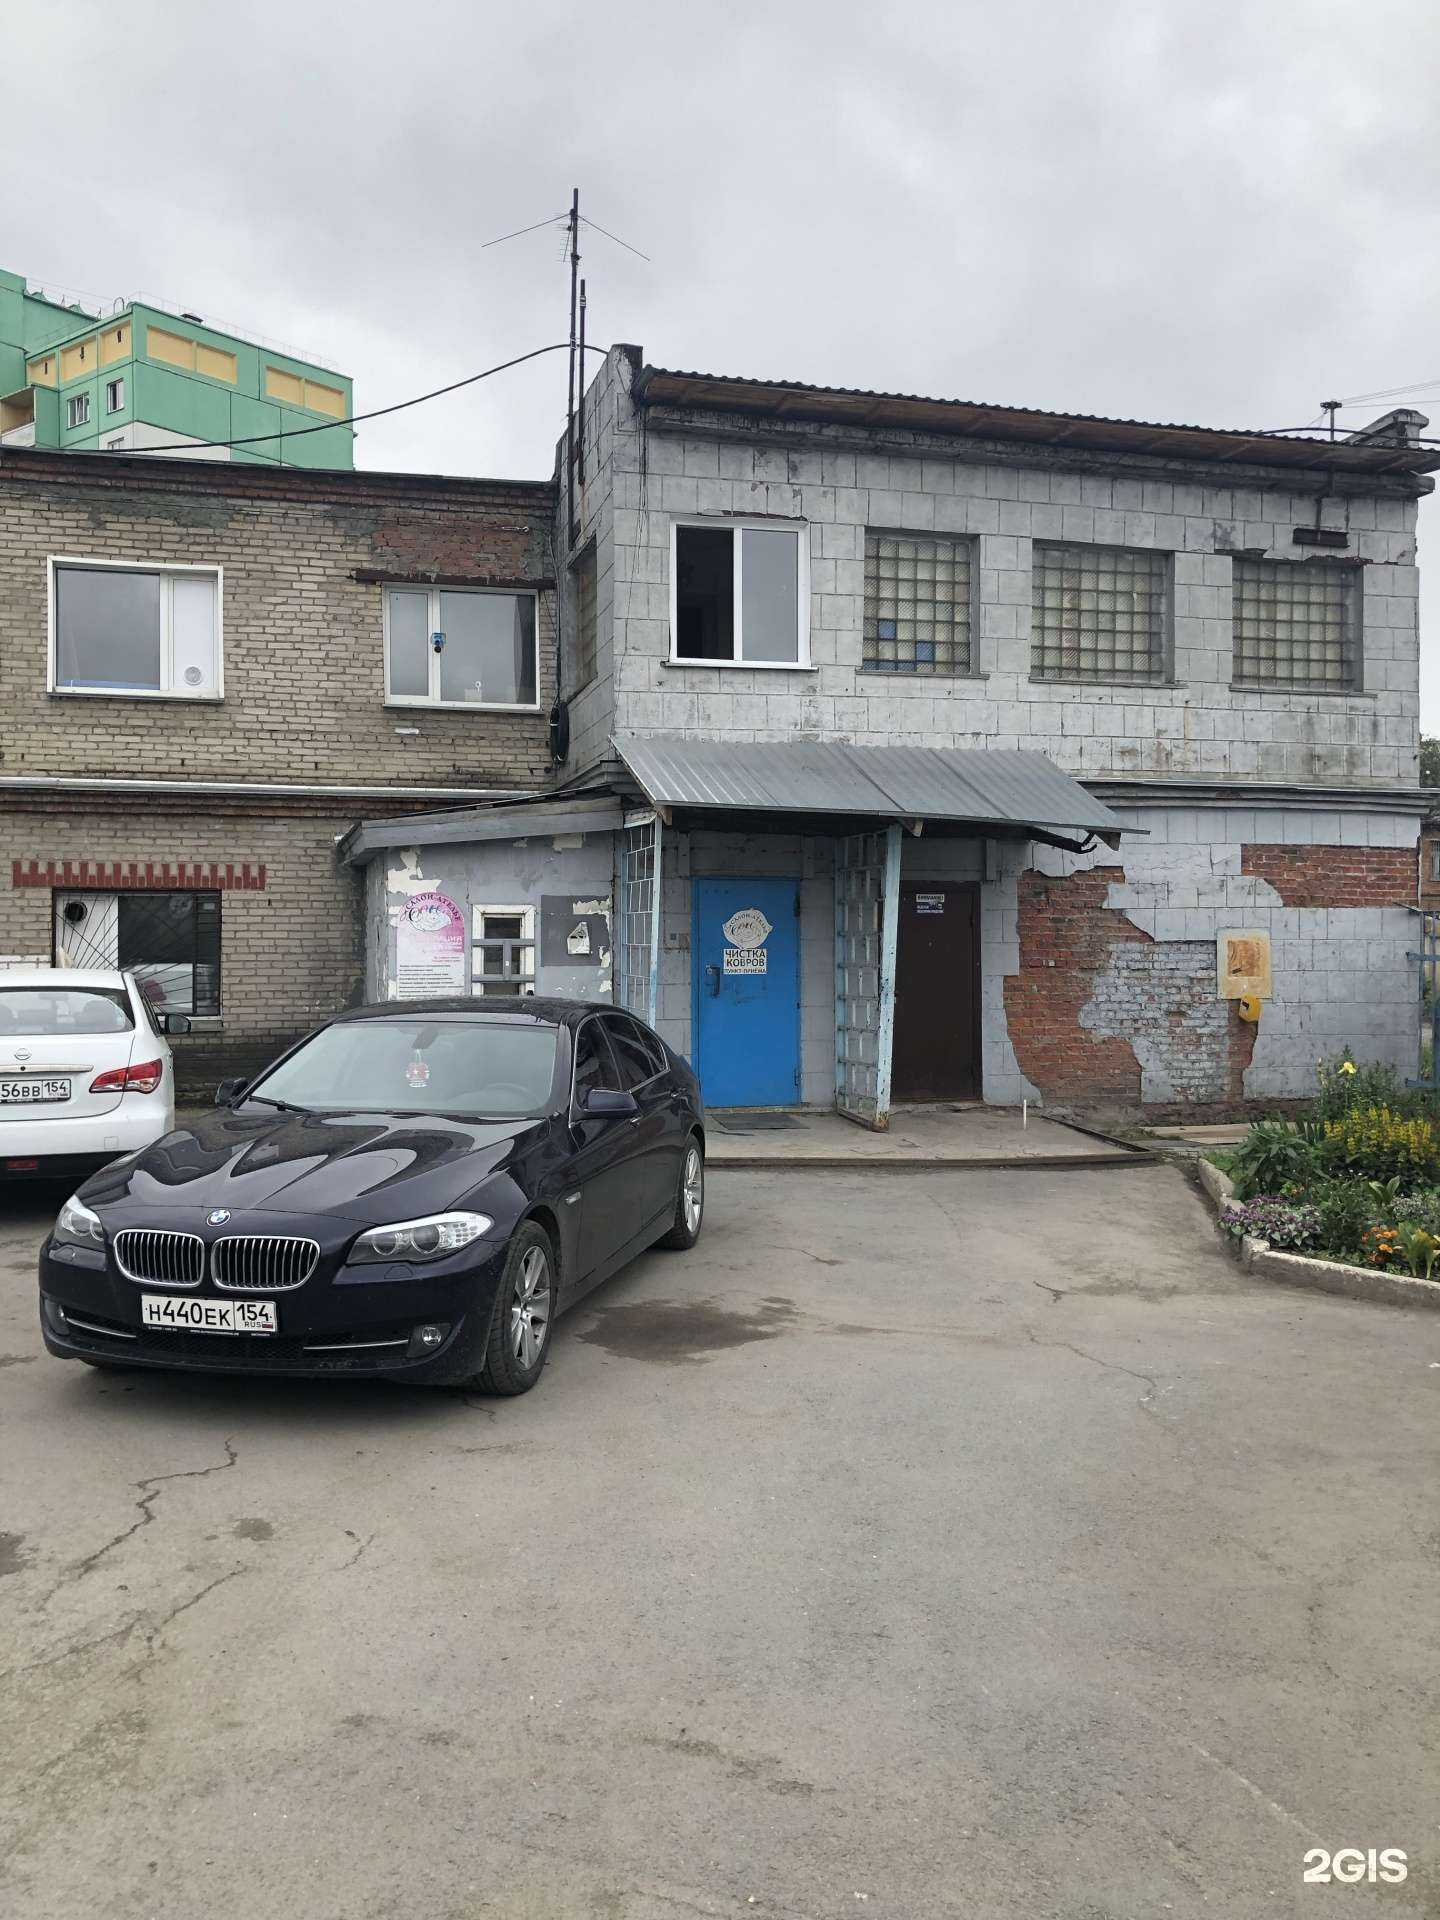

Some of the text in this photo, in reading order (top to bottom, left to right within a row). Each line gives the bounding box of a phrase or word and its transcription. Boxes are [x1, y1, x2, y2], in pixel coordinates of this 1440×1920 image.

[725, 949, 765, 958] ЧИСТКА
[726, 959, 765, 967] КОВРОВ
[44, 1081, 68, 1092] 154
[236, 1303, 270, 1322] 154
